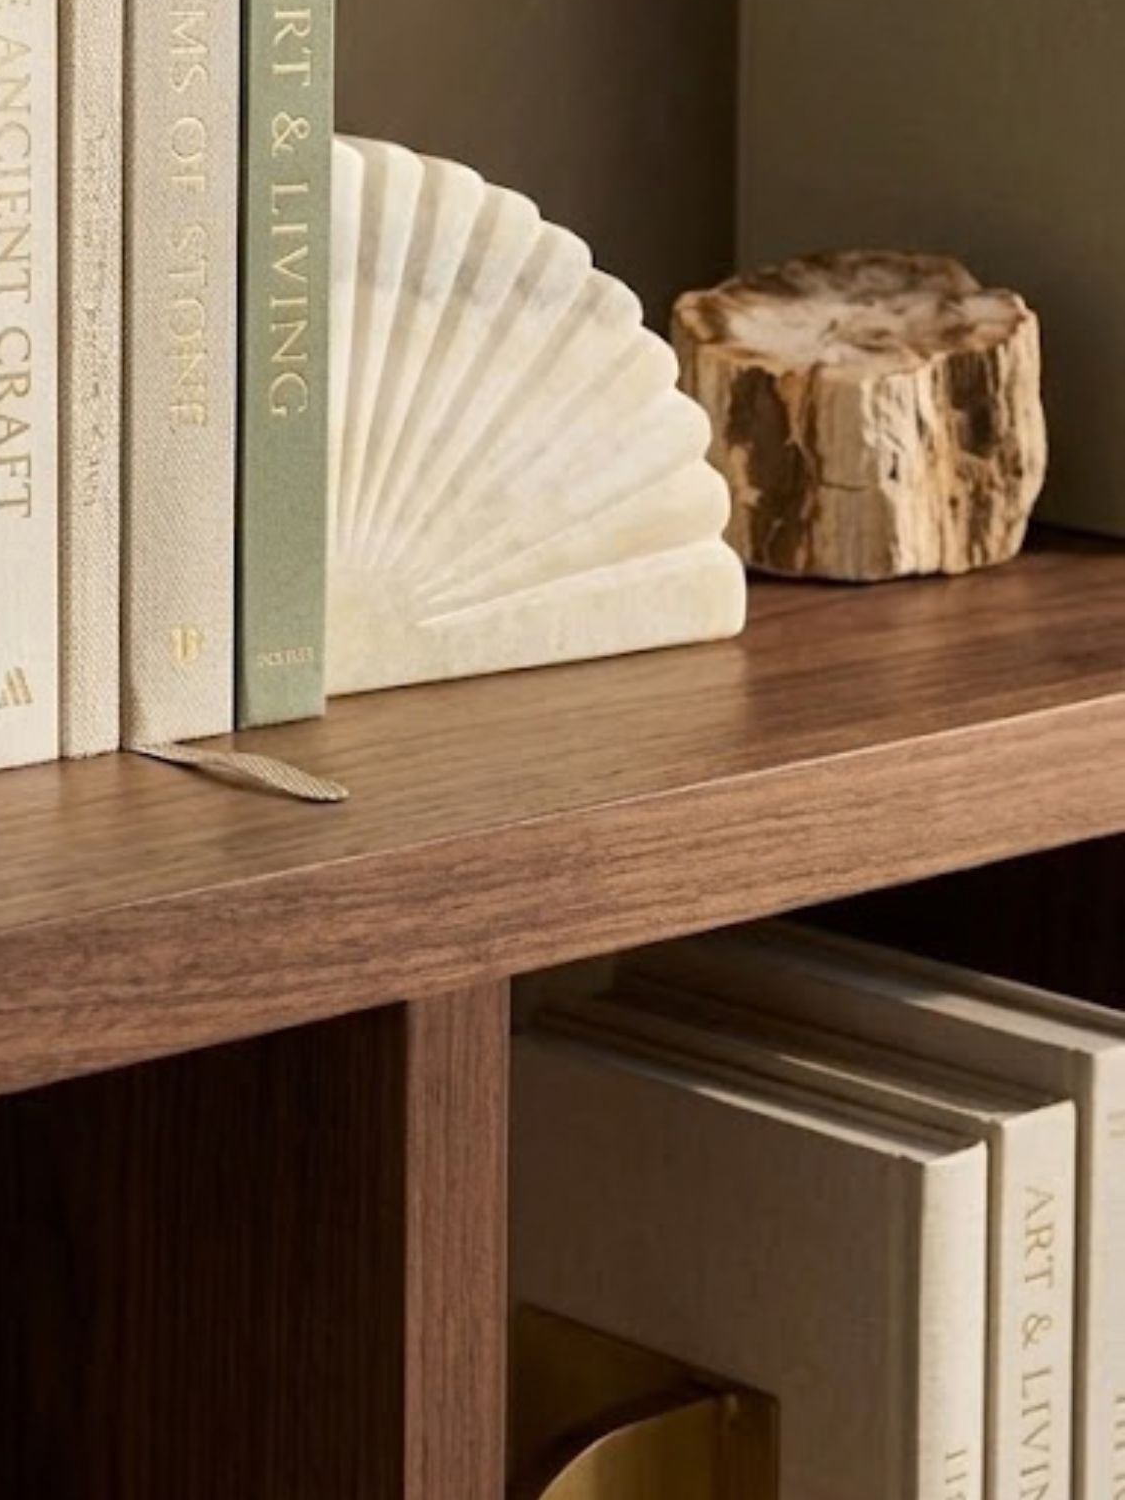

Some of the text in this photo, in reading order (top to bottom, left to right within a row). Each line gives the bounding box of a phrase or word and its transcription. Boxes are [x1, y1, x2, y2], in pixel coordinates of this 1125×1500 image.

[169, 116, 206, 197] OF
[271, 110, 311, 157] &
[270, 183, 309, 418] LIVING
[1024, 1185, 1056, 1288] ART
[1022, 1312, 1052, 1349] &
